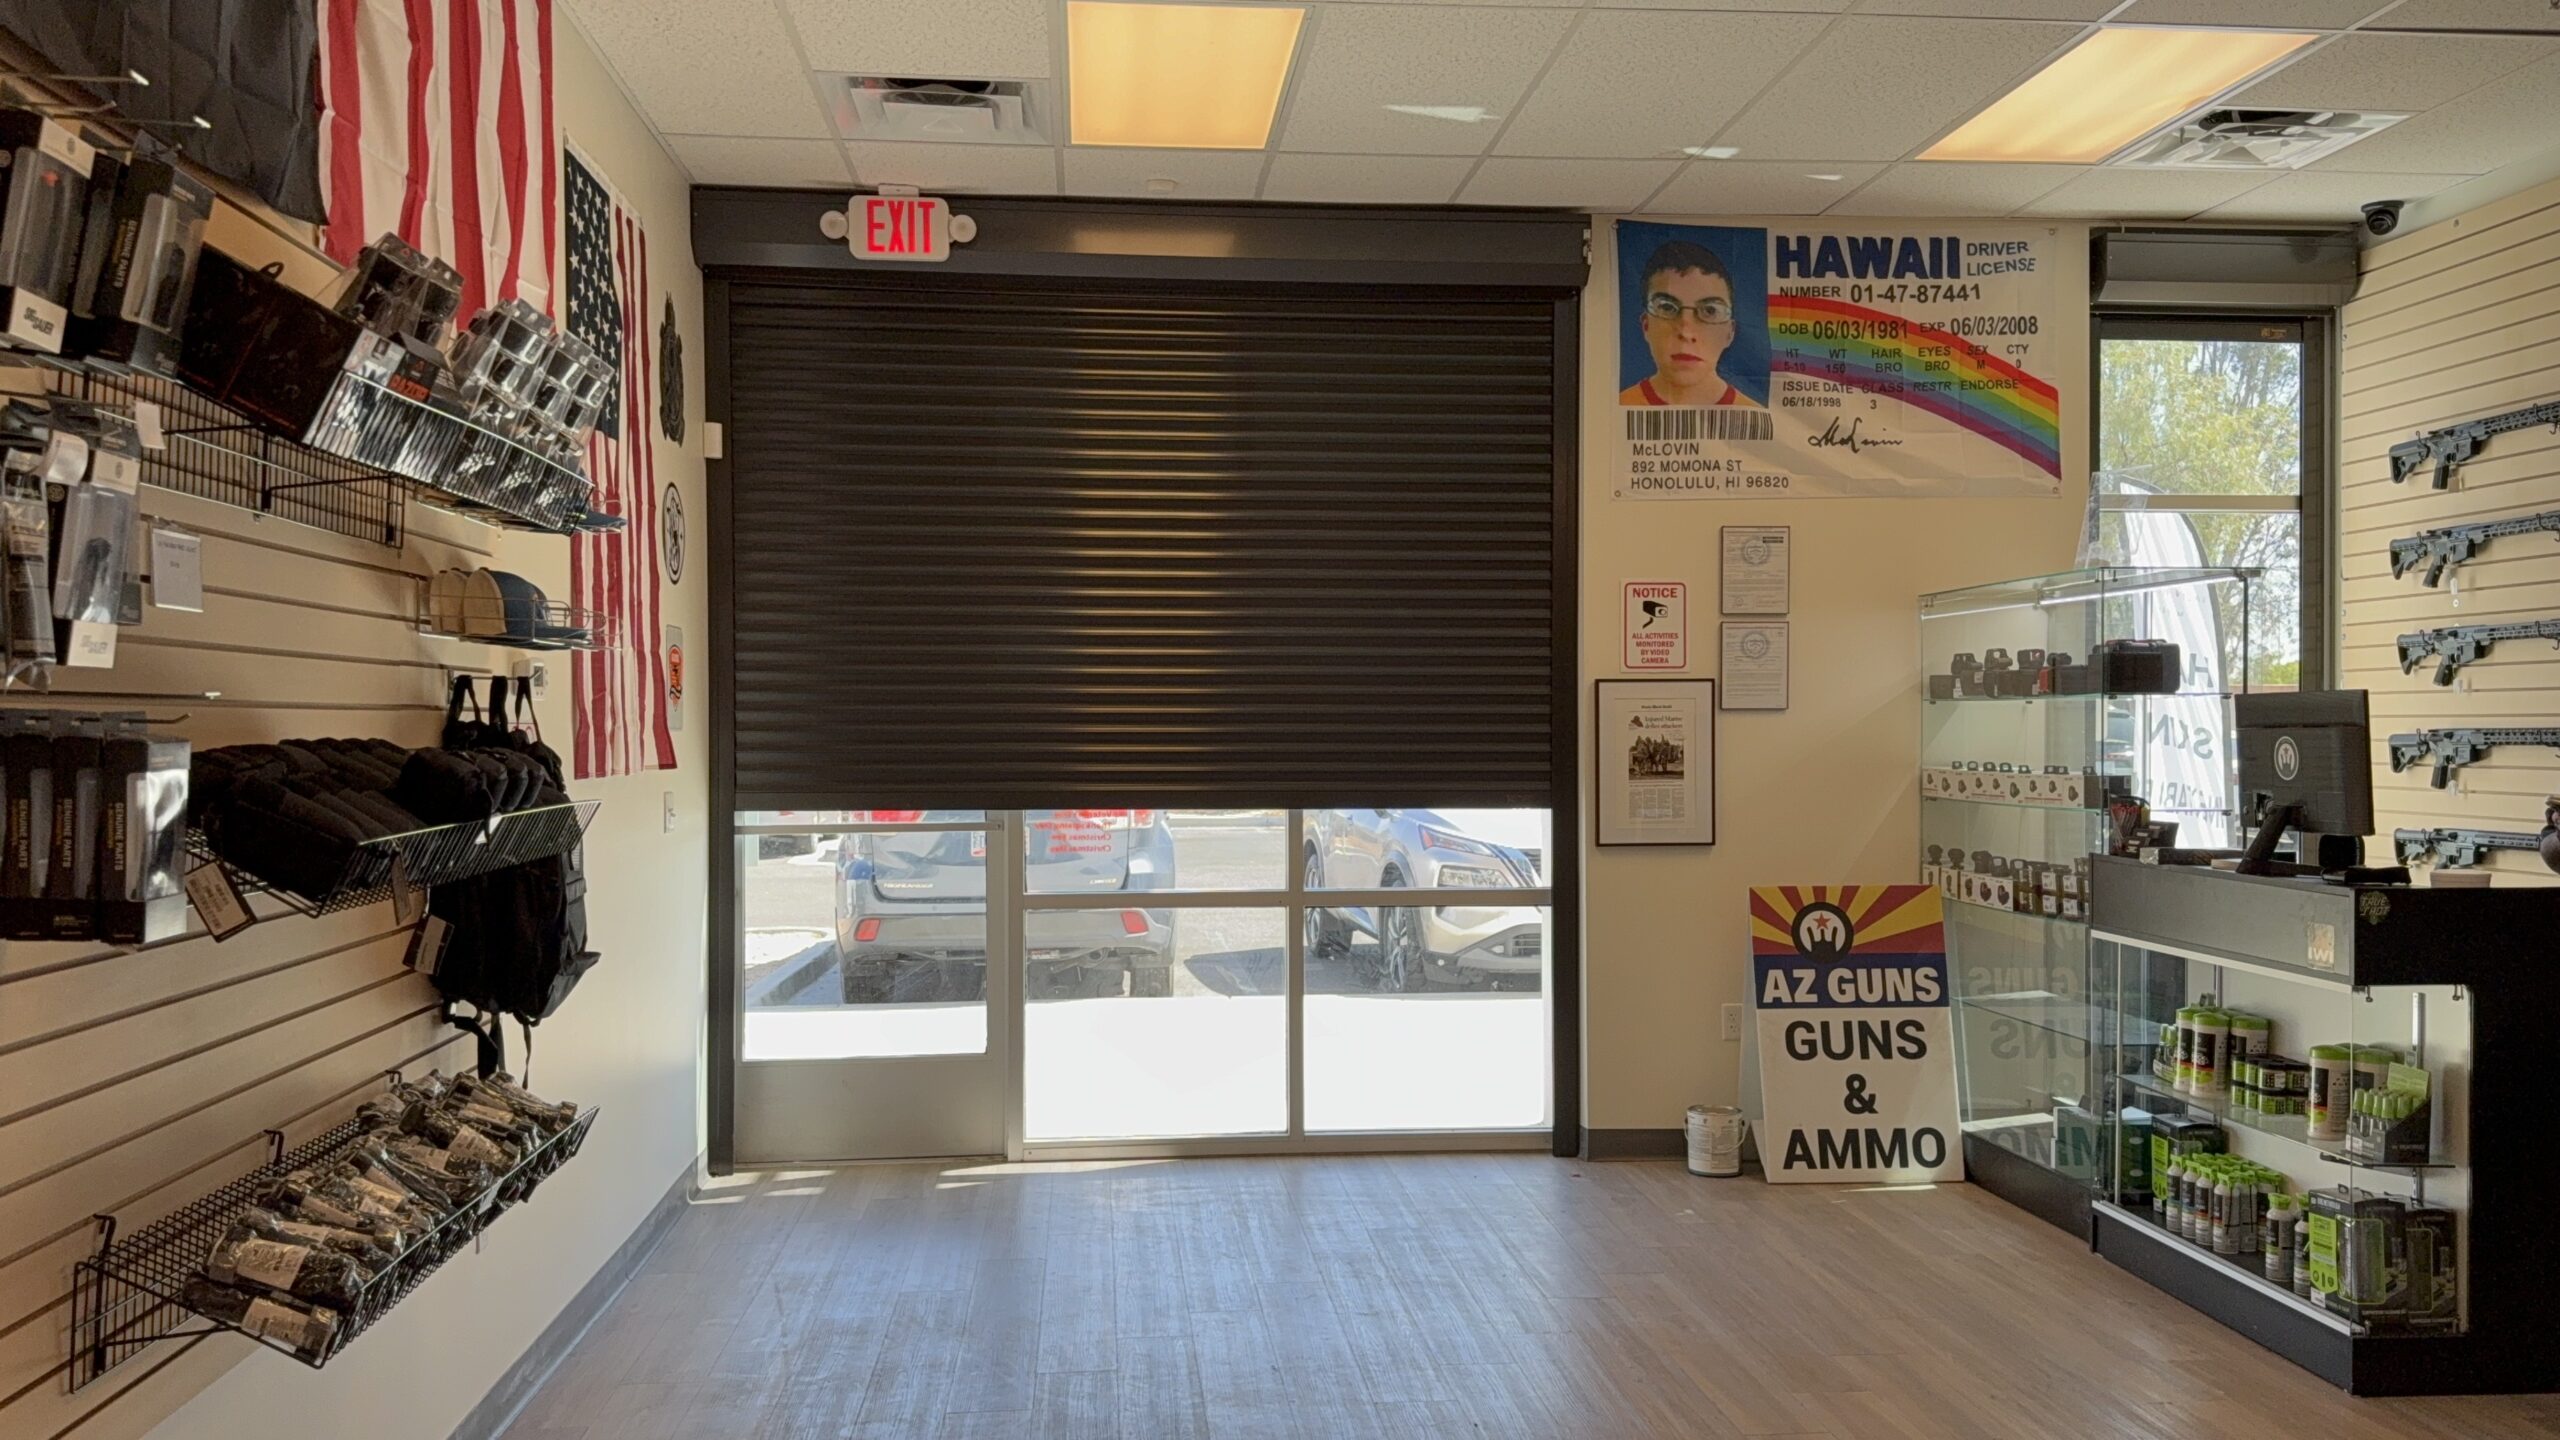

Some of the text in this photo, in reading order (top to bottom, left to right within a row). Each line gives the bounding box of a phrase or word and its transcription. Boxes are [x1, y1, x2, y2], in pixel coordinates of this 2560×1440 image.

[867, 199, 935, 254] EXIT
[120, 220, 138, 258] GENUINE
[1776, 236, 1960, 279] HAWAII
[1966, 241, 2029, 256] DRIVER
[113, 259, 129, 288] PARTS
[1967, 258, 2036, 276] LICENSE
[1779, 283, 1981, 303] NUMBER 01-47-87441
[1779, 316, 2038, 339] DOB 06/03/1981 EXP 06/03/2008
[1786, 344, 2029, 359] HT WT HAIR EYES SEX CTY
[1826, 363, 1846, 374] 150
[1875, 362, 1902, 373] BRO
[1924, 360, 1950, 371] BRO
[1977, 360, 1985, 370] M
[1783, 379, 2019, 394] ISSUE DATE CLASS RESTR ENDORSE
[1782, 396, 1877, 410] 06/18/1998 3
[1633, 442, 1700, 456] McLOVIN
[1632, 460, 1742, 473] 892 MOMONA ST
[1631, 476, 1789, 490] HONOLULU, HI 96820
[1632, 587, 1678, 598] NOTICE
[1632, 632, 1679, 640] ALL ACTIVITIES
[19, 799, 28, 868] GENUINE PARTS
[63, 799, 73, 868] GENUINE PARTS
[115, 802, 124, 871] GENUINE PARTS
[2360, 905, 2391, 916] SHOT
[2362, 897, 2387, 906] TRUE
[2308, 946, 2334, 964] IWI
[1762, 966, 1941, 1004] AZ GUNS
[1785, 1019, 1927, 1061] GUNS
[1844, 1073, 1878, 1115] &
[1783, 1127, 1946, 1170] AMMO
